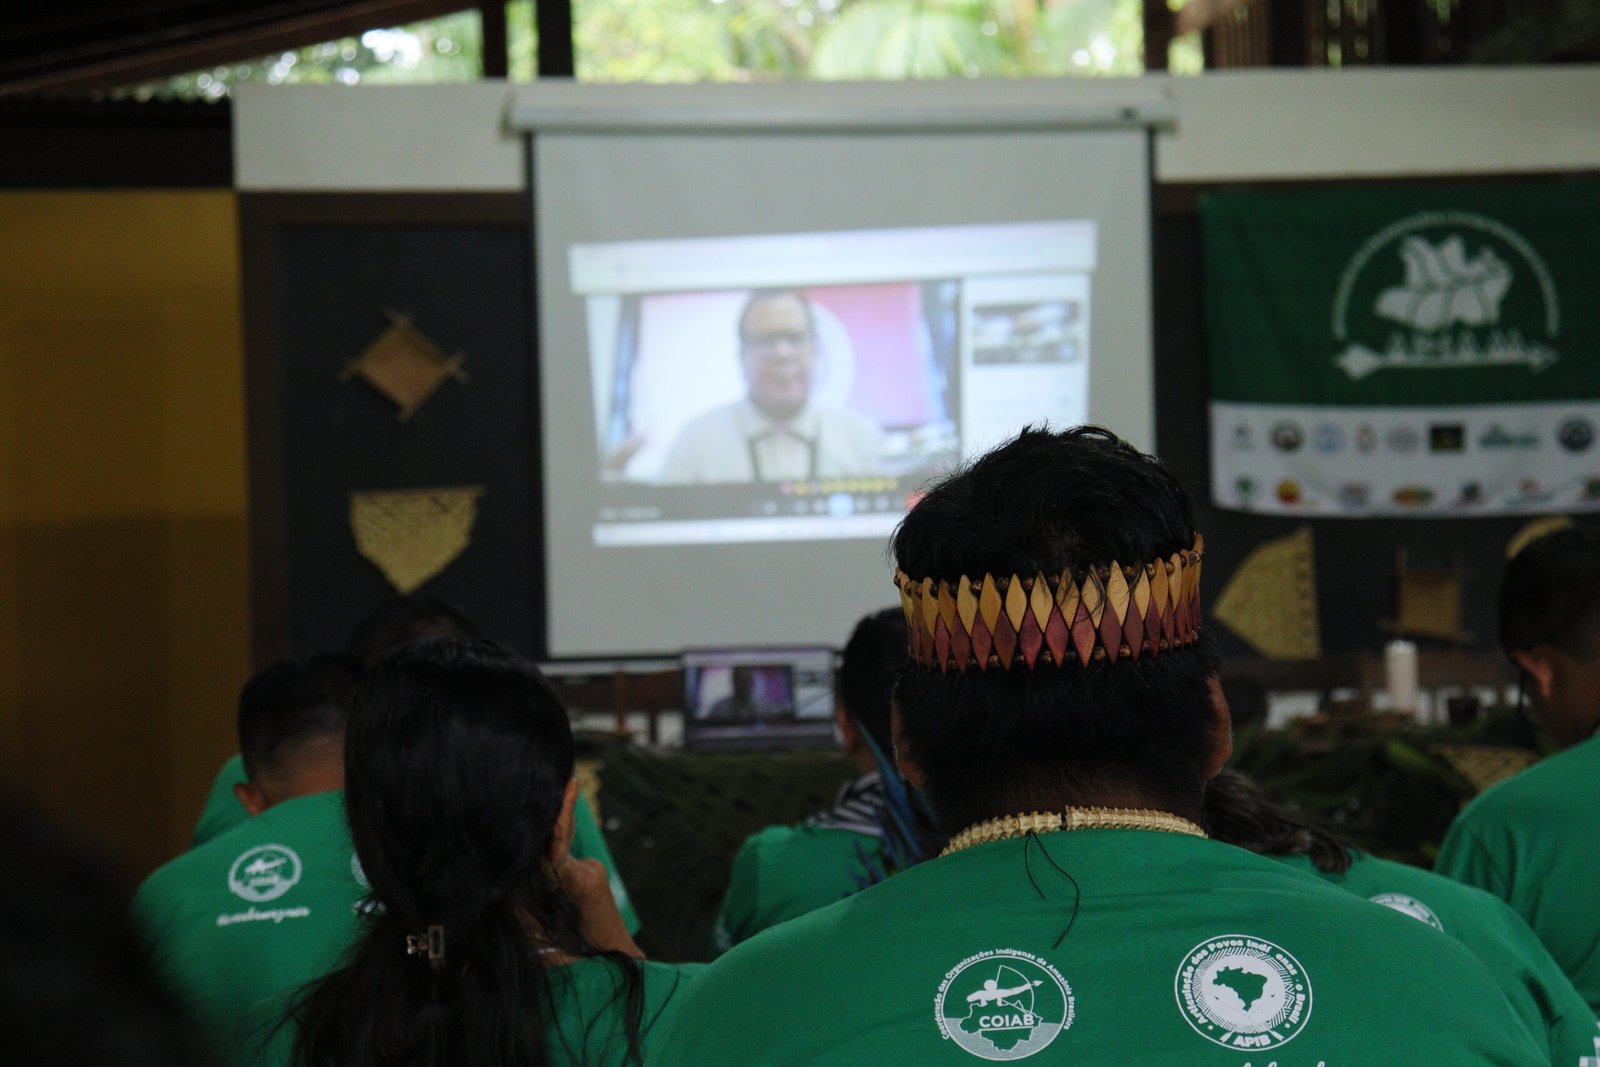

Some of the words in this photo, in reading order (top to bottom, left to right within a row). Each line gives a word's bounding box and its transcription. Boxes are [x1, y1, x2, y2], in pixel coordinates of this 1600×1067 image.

[995, 948, 1036, 961] Indígenas
[1036, 957, 1047, 966] da
[1191, 949, 1209, 965] dos
[1207, 939, 1244, 952] Povos
[945, 950, 994, 979] Organizações
[938, 980, 948, 992] das
[1046, 964, 1073, 995] Amazônia
[934, 993, 949, 1040] Coordenação
[979, 1013, 1035, 1028] COIAB
[1063, 996, 1076, 1030] Brasileira
[1233, 1034, 1271, 1047] APIB
